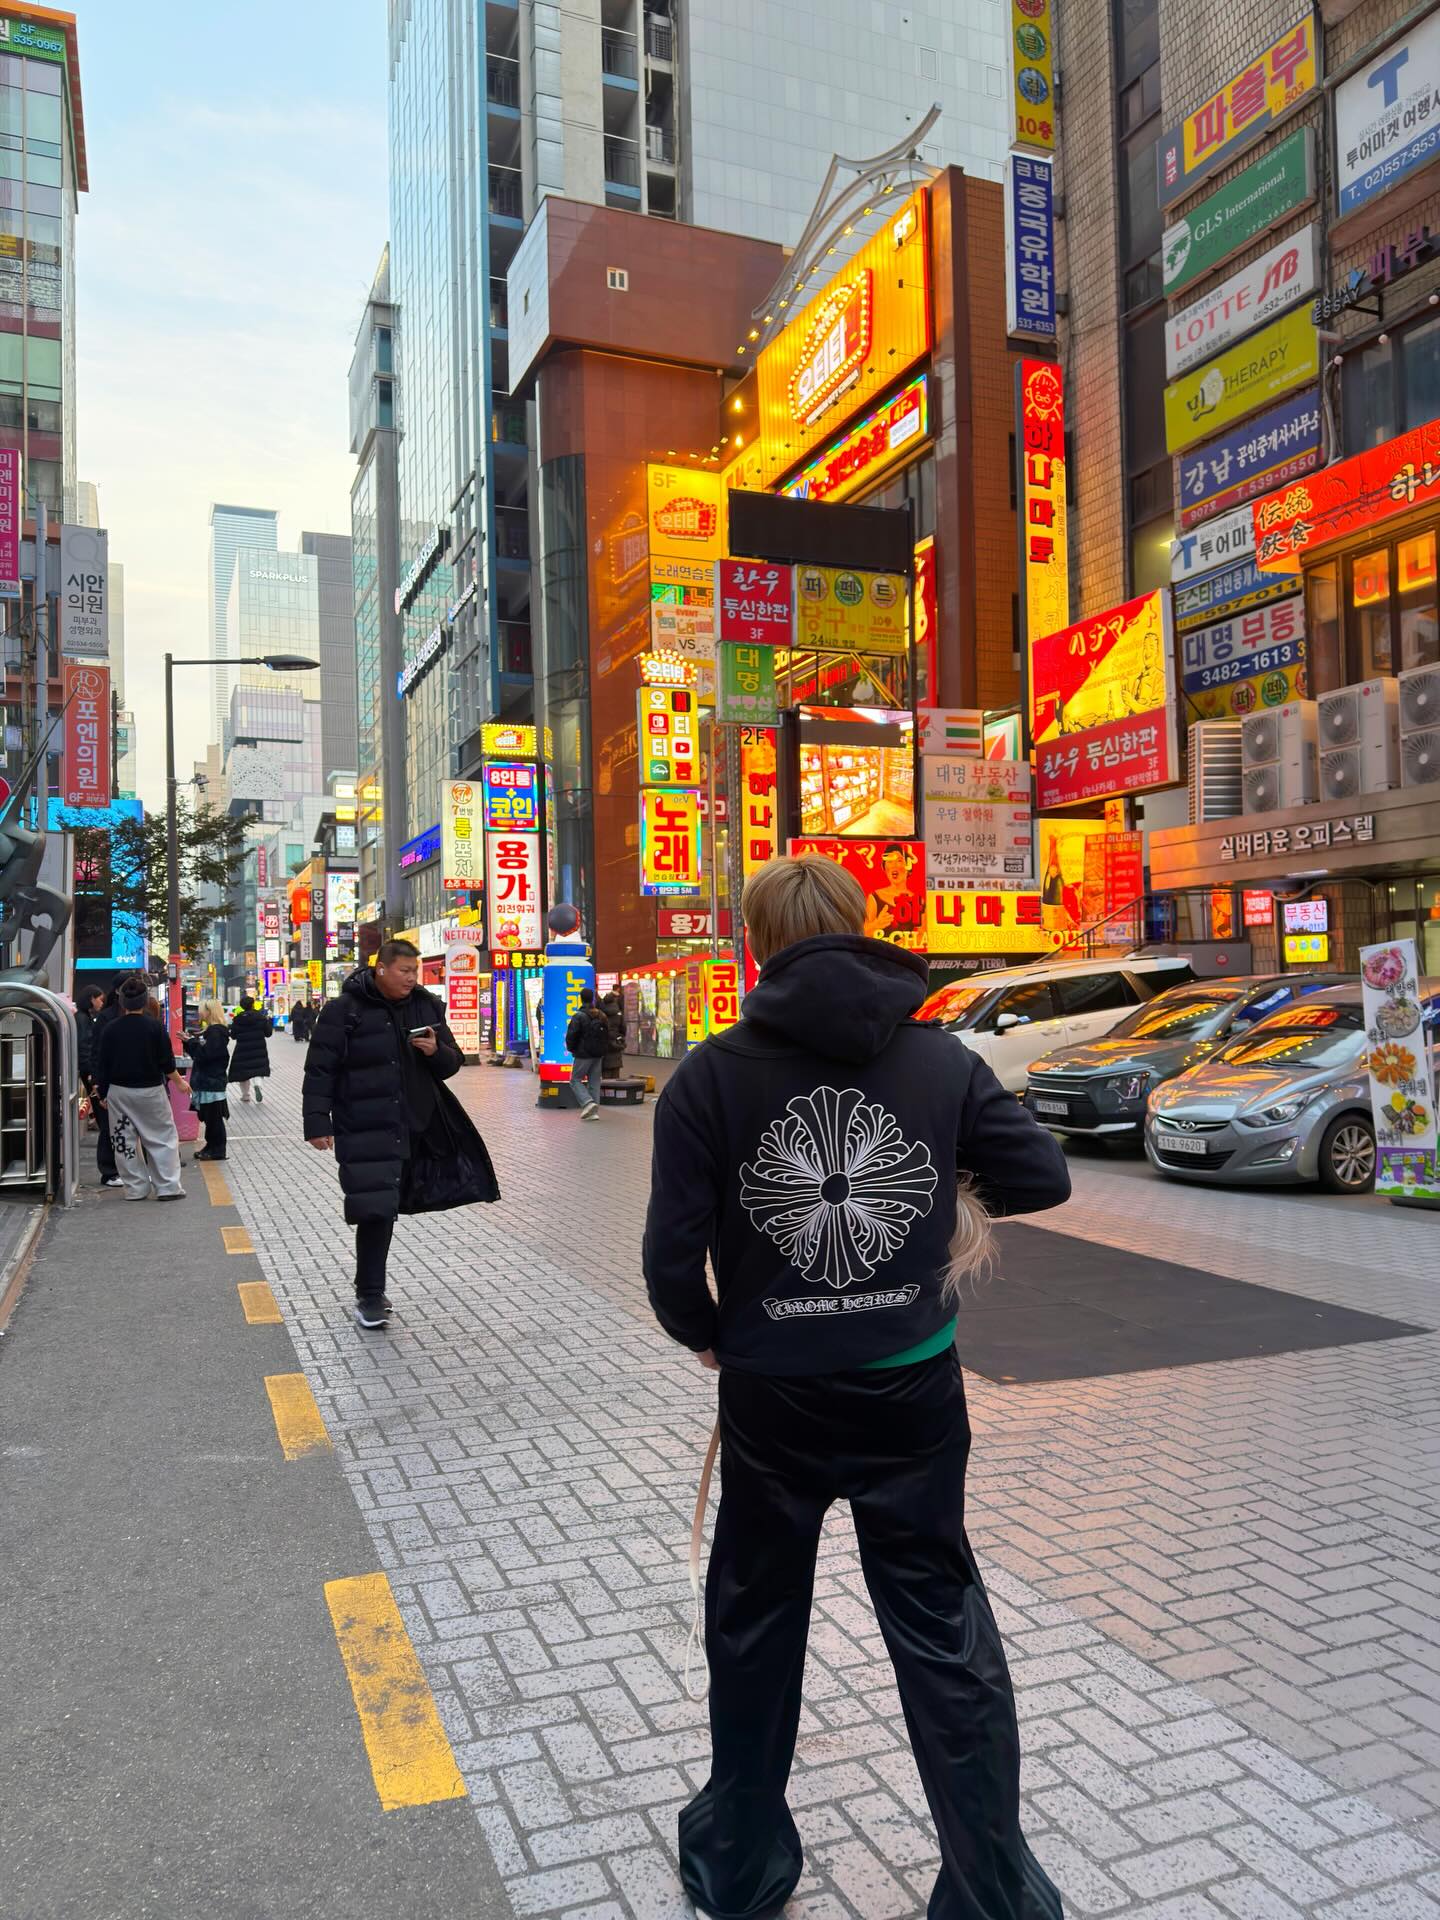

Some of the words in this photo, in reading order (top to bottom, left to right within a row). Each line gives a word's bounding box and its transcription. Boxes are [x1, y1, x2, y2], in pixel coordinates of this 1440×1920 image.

[1193, 25, 1309, 158] 파출부
[1346, 120, 1400, 170] 투어마켓
[1194, 211, 1223, 241] GLS
[1226, 166, 1286, 220] International
[1175, 285, 1251, 352] LOTTE
[1223, 343, 1289, 393] THERAPY
[653, 471, 677, 489] 5F
[1185, 449, 1234, 496] 강남
[1200, 525, 1253, 560] 투어마
[66, 573, 106, 595] 시안
[249, 570, 308, 583] SPARKPLUS
[732, 566, 779, 597] 한우
[806, 574, 893, 605] 퍼펙트
[66, 593, 106, 614] 의원
[723, 597, 789, 626] 등심한판
[679, 638, 697, 650] VS
[749, 627, 765, 641] 3F
[1184, 623, 1233, 668] 대명
[1242, 603, 1304, 649] 부동
[736, 648, 760, 693] 대명
[1202, 645, 1291, 686] 3482-1613
[75, 700, 100, 790] 포엔의원
[1043, 747, 1081, 780] 한우
[1085, 726, 1157, 772] 등심한판
[490, 769, 532, 787] 8인룸
[936, 765, 966, 785] 대명
[971, 765, 1019, 787] 부동산
[490, 797, 533, 819] 코인
[653, 796, 690, 873] 노래
[1219, 828, 1290, 860] 실버타운
[1293, 815, 1374, 850] 오피스텔
[496, 840, 531, 902] 용가
[1286, 903, 1326, 922] 부동산
[445, 929, 482, 942] NETFLIX
[495, 953, 508, 966] B1
[1179, 1139, 1201, 1152] 9620
[775, 1299, 840, 1316] CHROME
[842, 1291, 908, 1312] HEARTS
